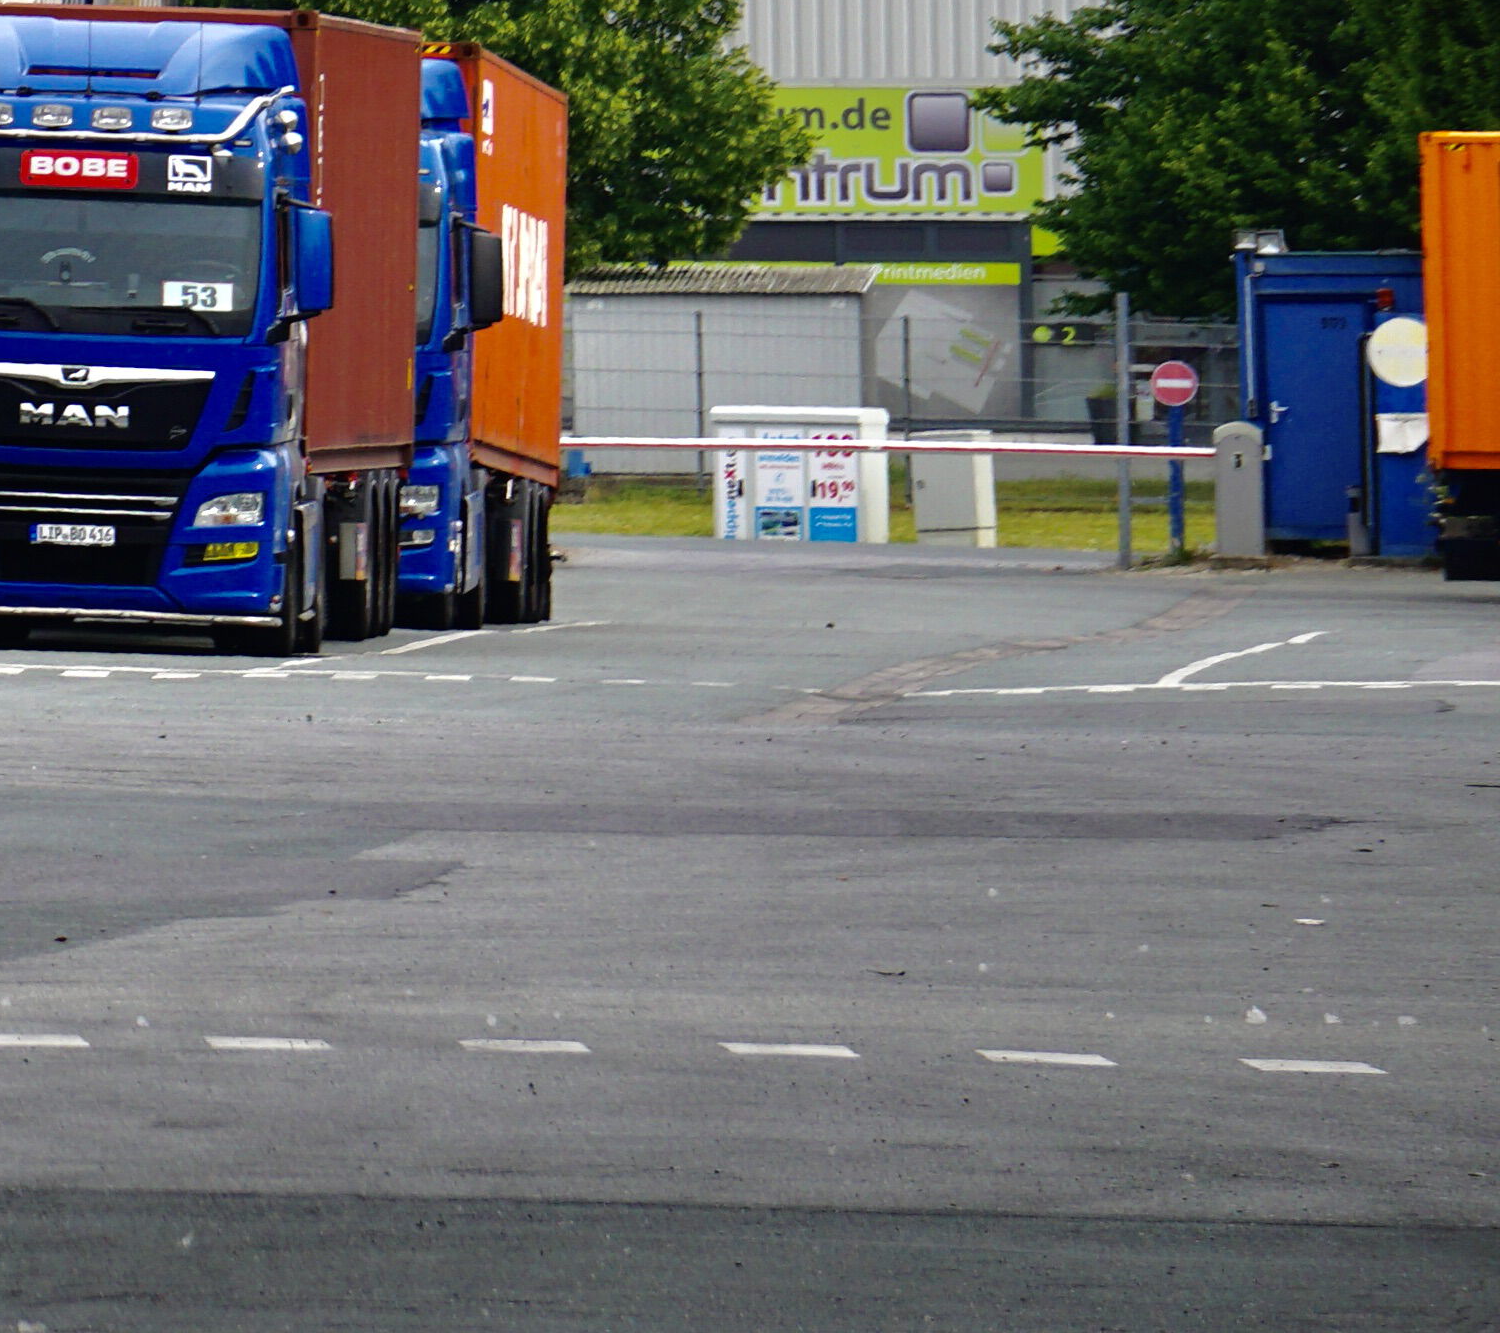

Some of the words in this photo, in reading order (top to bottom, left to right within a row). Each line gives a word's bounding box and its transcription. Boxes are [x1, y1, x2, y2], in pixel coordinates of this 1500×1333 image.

[29, 155, 129, 178] BOBE
[167, 181, 212, 193] MAN
[180, 284, 218, 309] 53
[1060, 326, 1077, 346] 2
[19, 402, 130, 429] MAN
